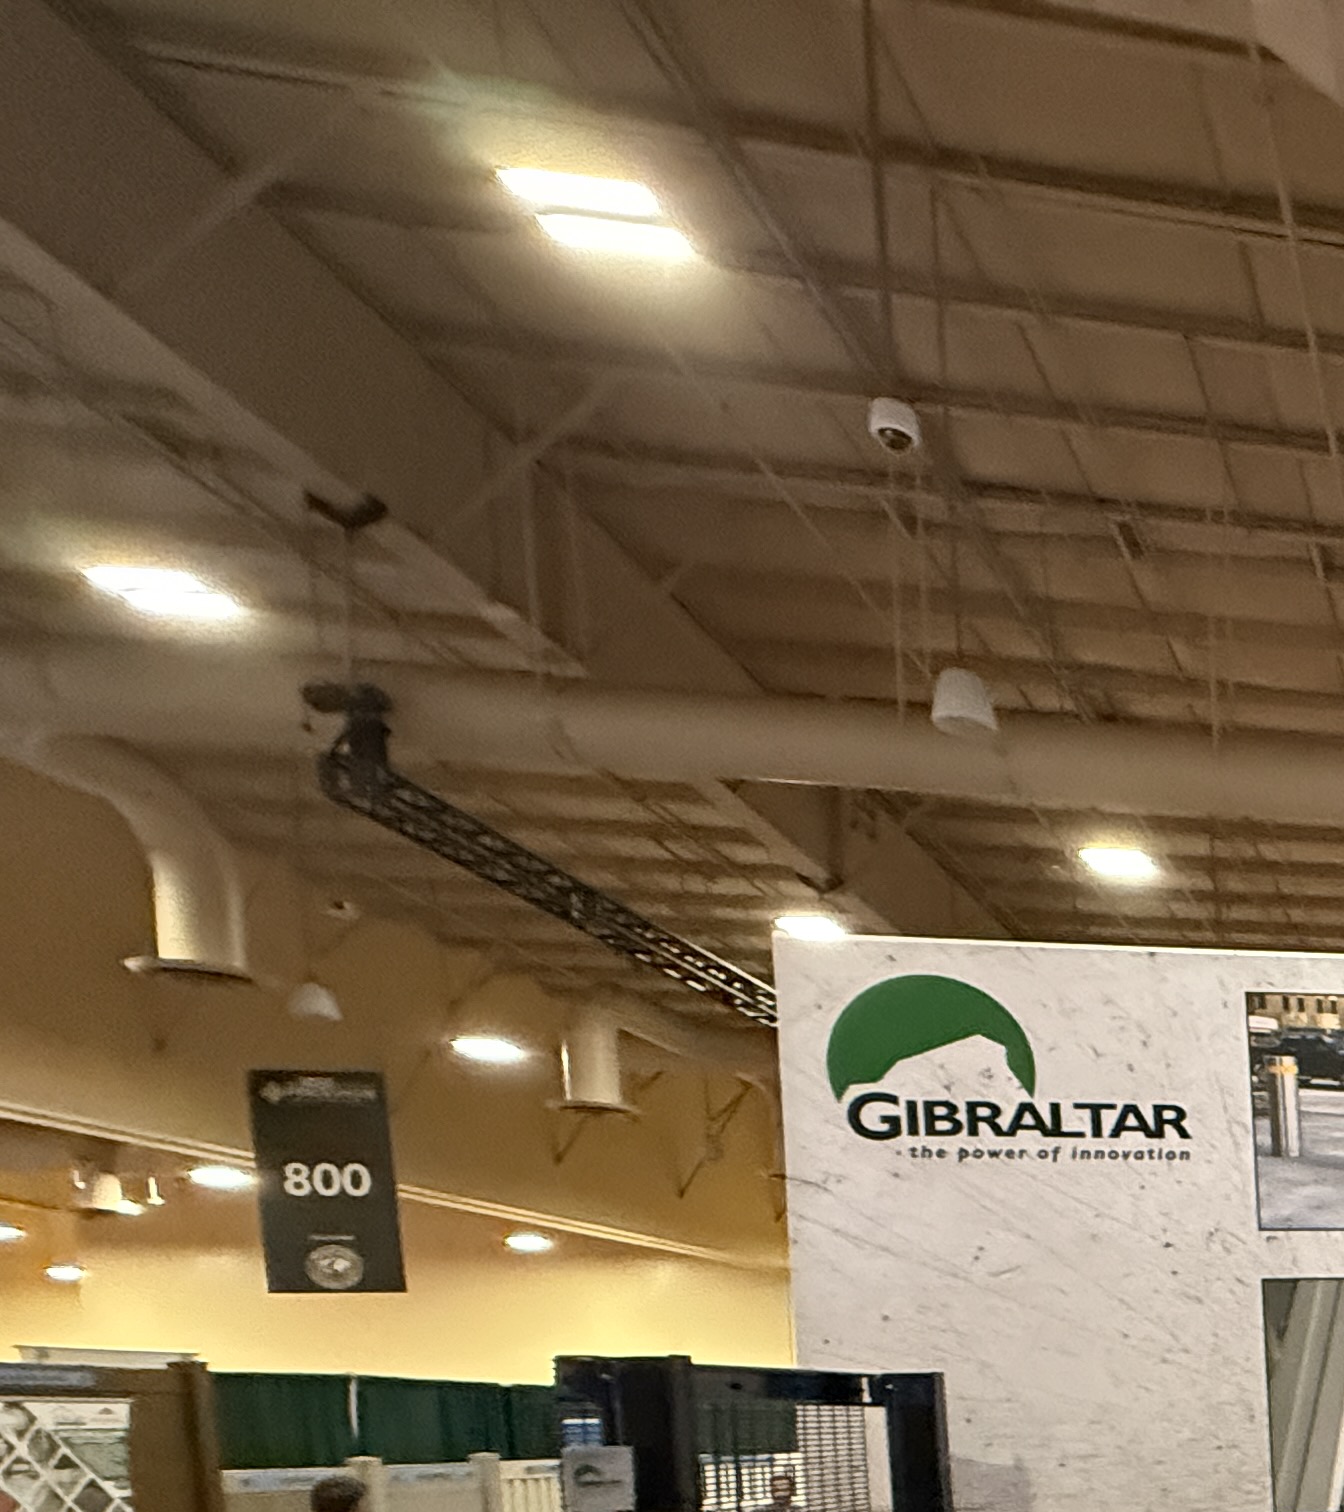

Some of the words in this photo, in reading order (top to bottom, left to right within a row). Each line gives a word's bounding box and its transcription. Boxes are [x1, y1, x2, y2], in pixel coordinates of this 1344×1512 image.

[846, 1091, 1192, 1141] GIBRALTAR
[909, 1145, 948, 1159] the
[957, 1148, 1027, 1163] power
[1037, 1146, 1062, 1163] of
[1071, 1147, 1192, 1161] innovation
[283, 1162, 372, 1197] 800
